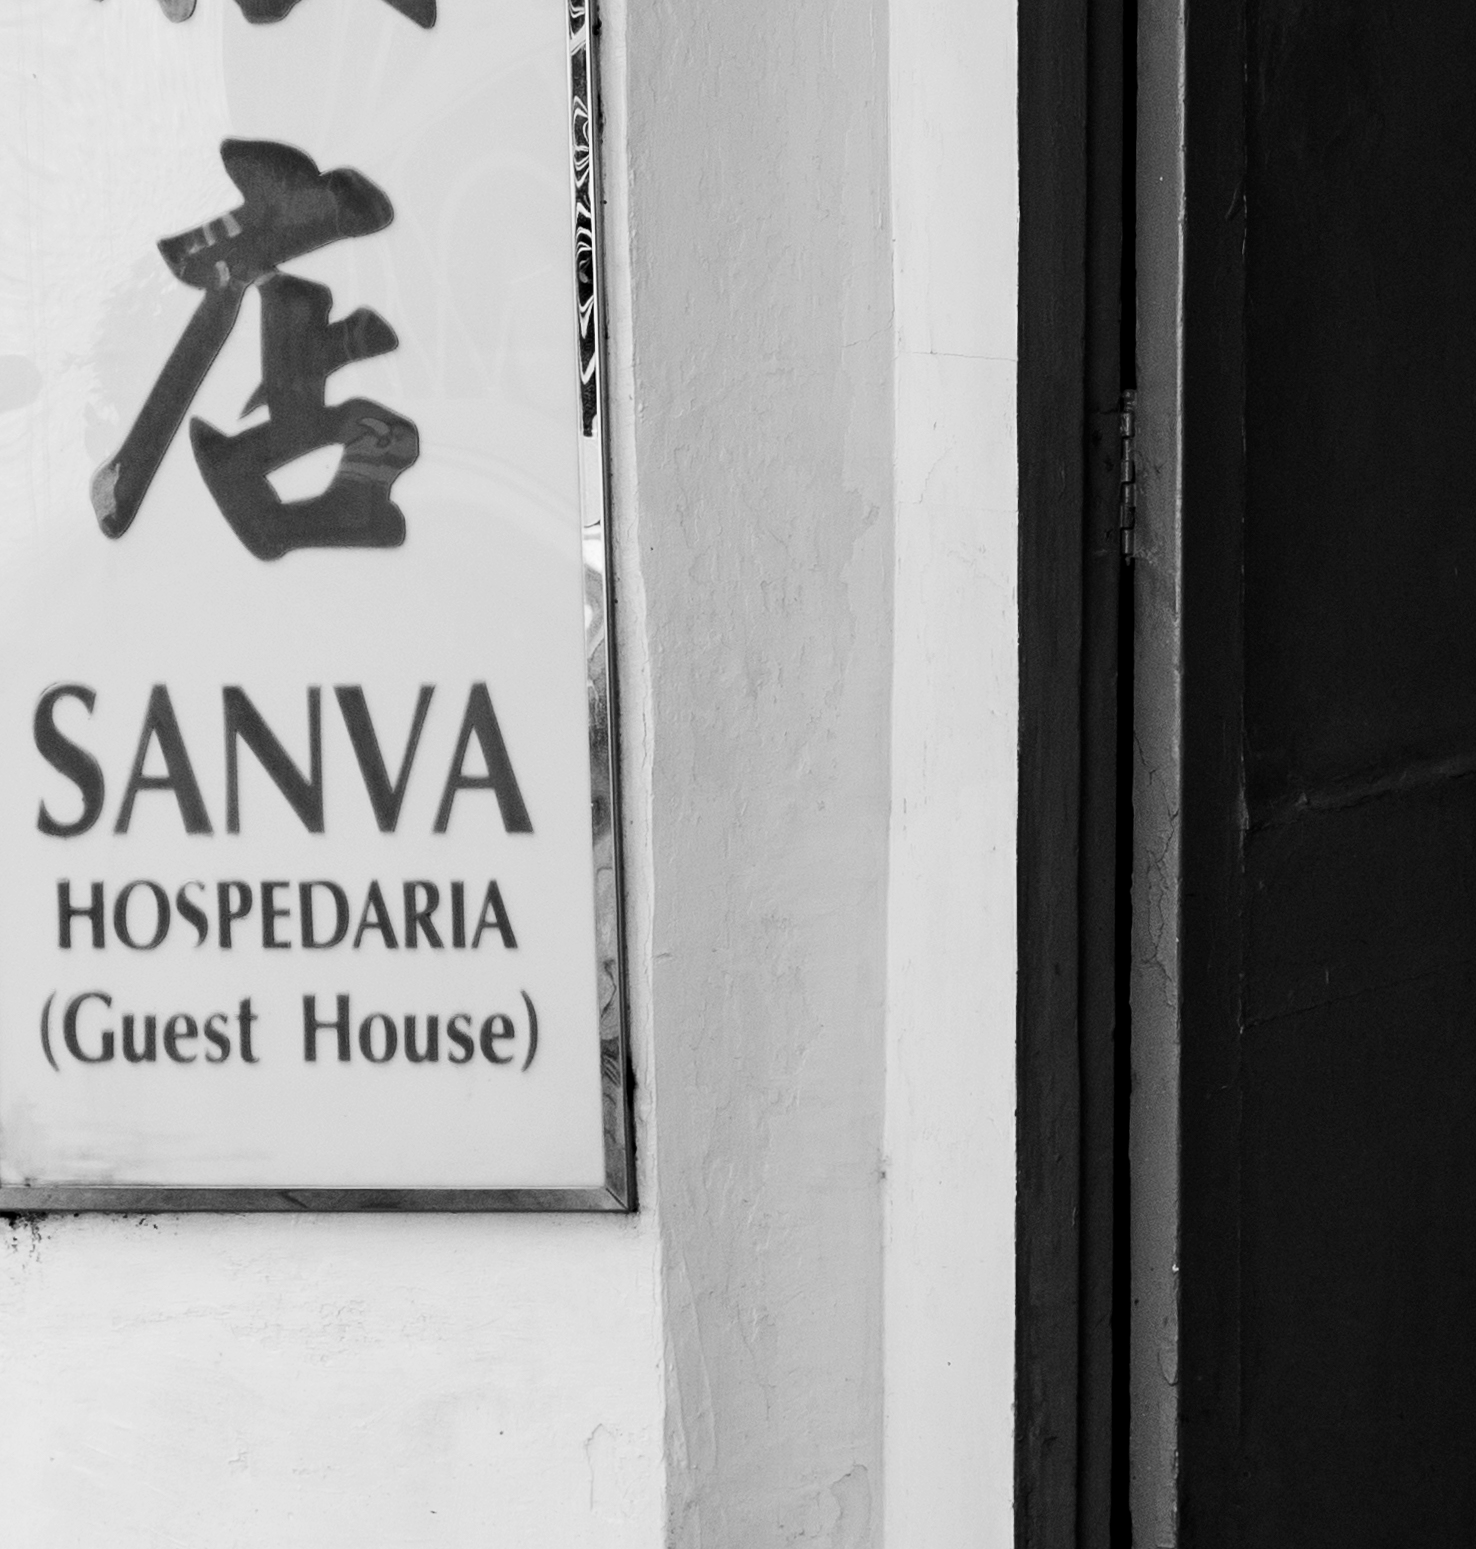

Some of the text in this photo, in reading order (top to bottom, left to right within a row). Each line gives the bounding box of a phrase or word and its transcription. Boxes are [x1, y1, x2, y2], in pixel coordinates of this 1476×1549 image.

[33, 682, 534, 839] SANVA
[57, 879, 519, 952] HOSPEDARIA
[40, 990, 540, 1072] (Guest House)
